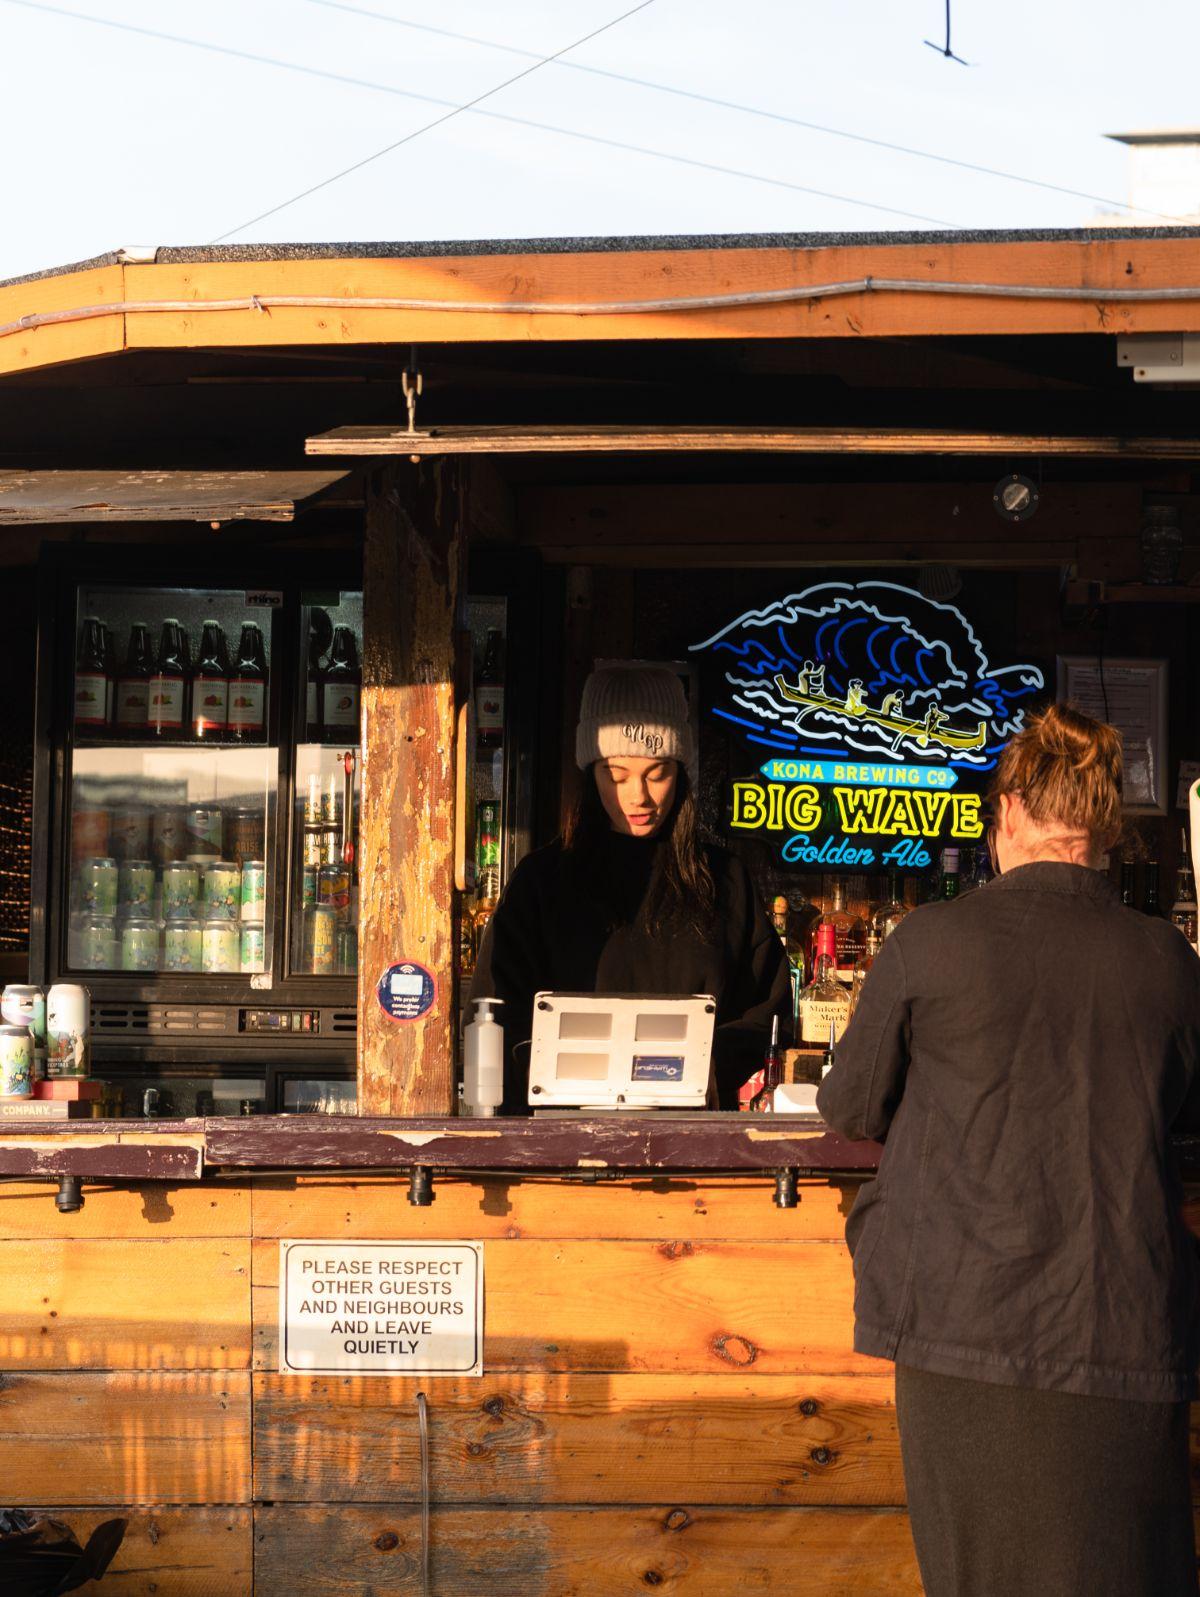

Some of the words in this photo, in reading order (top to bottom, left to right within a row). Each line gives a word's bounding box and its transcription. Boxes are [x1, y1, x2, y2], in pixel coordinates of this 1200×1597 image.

[772, 761, 825, 780] KONA
[833, 764, 920, 785] BREWING
[730, 782, 823, 833] BIG
[832, 786, 984, 839] WAVE
[781, 833, 876, 865] Golden
[881, 838, 932, 868] Ale
[809, 1004, 848, 1014] Maker's
[821, 1014, 847, 1022] Mark
[302, 1260, 373, 1275] PLEASE
[378, 1261, 463, 1276] RESPECT
[311, 1280, 373, 1295] OTHER
[379, 1281, 452, 1296] GUESTS
[299, 1300, 338, 1314] AND
[343, 1300, 464, 1315] NEIGHBOURS
[330, 1320, 369, 1334] AND
[375, 1321, 433, 1335] LEAVE
[343, 1340, 420, 1355] QUIETLY
